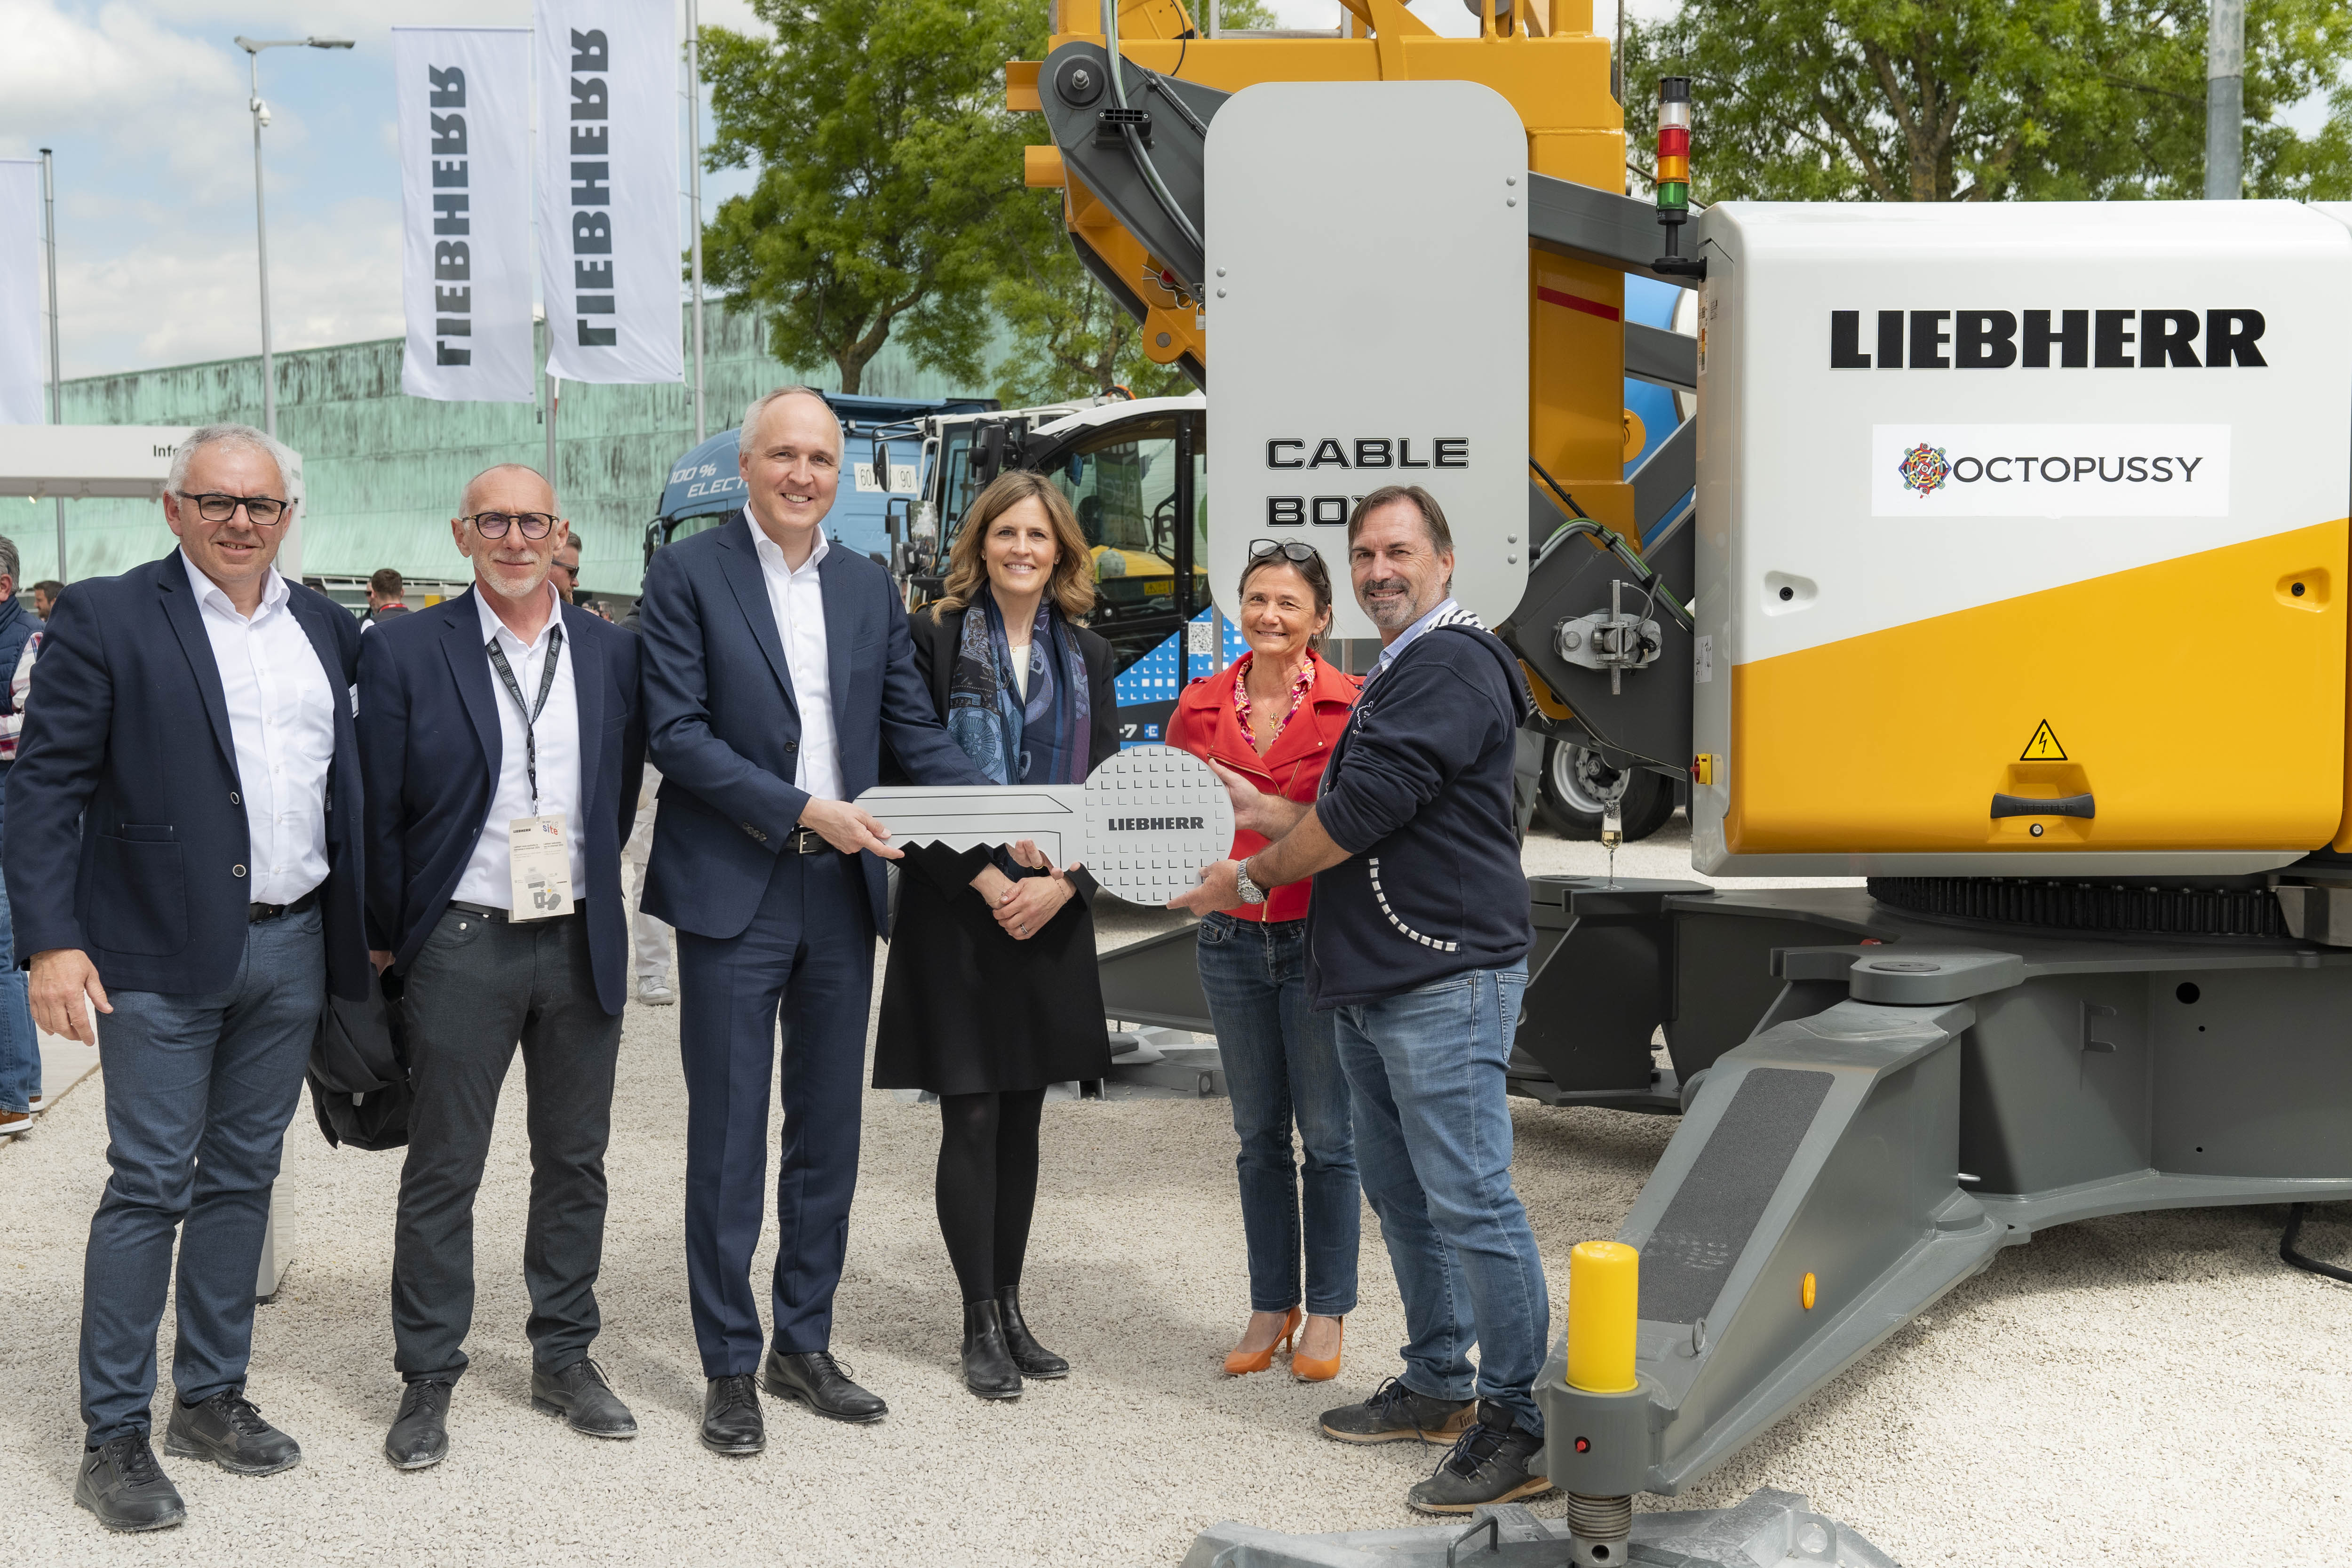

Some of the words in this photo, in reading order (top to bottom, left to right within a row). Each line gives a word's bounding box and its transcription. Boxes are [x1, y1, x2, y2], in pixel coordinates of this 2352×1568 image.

[1831, 310, 2268, 368] LIEBHERR
[1266, 438, 1468, 470] CABLE
[669, 467, 698, 485] 100
[699, 463, 717, 478] %
[860, 469, 872, 486] 60
[900, 470, 911, 487] 90
[1954, 457, 2202, 482] OCTOPUSSY
[687, 476, 748, 498] ELECT
[1266, 496, 1366, 527] BO
[542, 824, 558, 835] site
[1108, 817, 1205, 831] LIEBHERR
